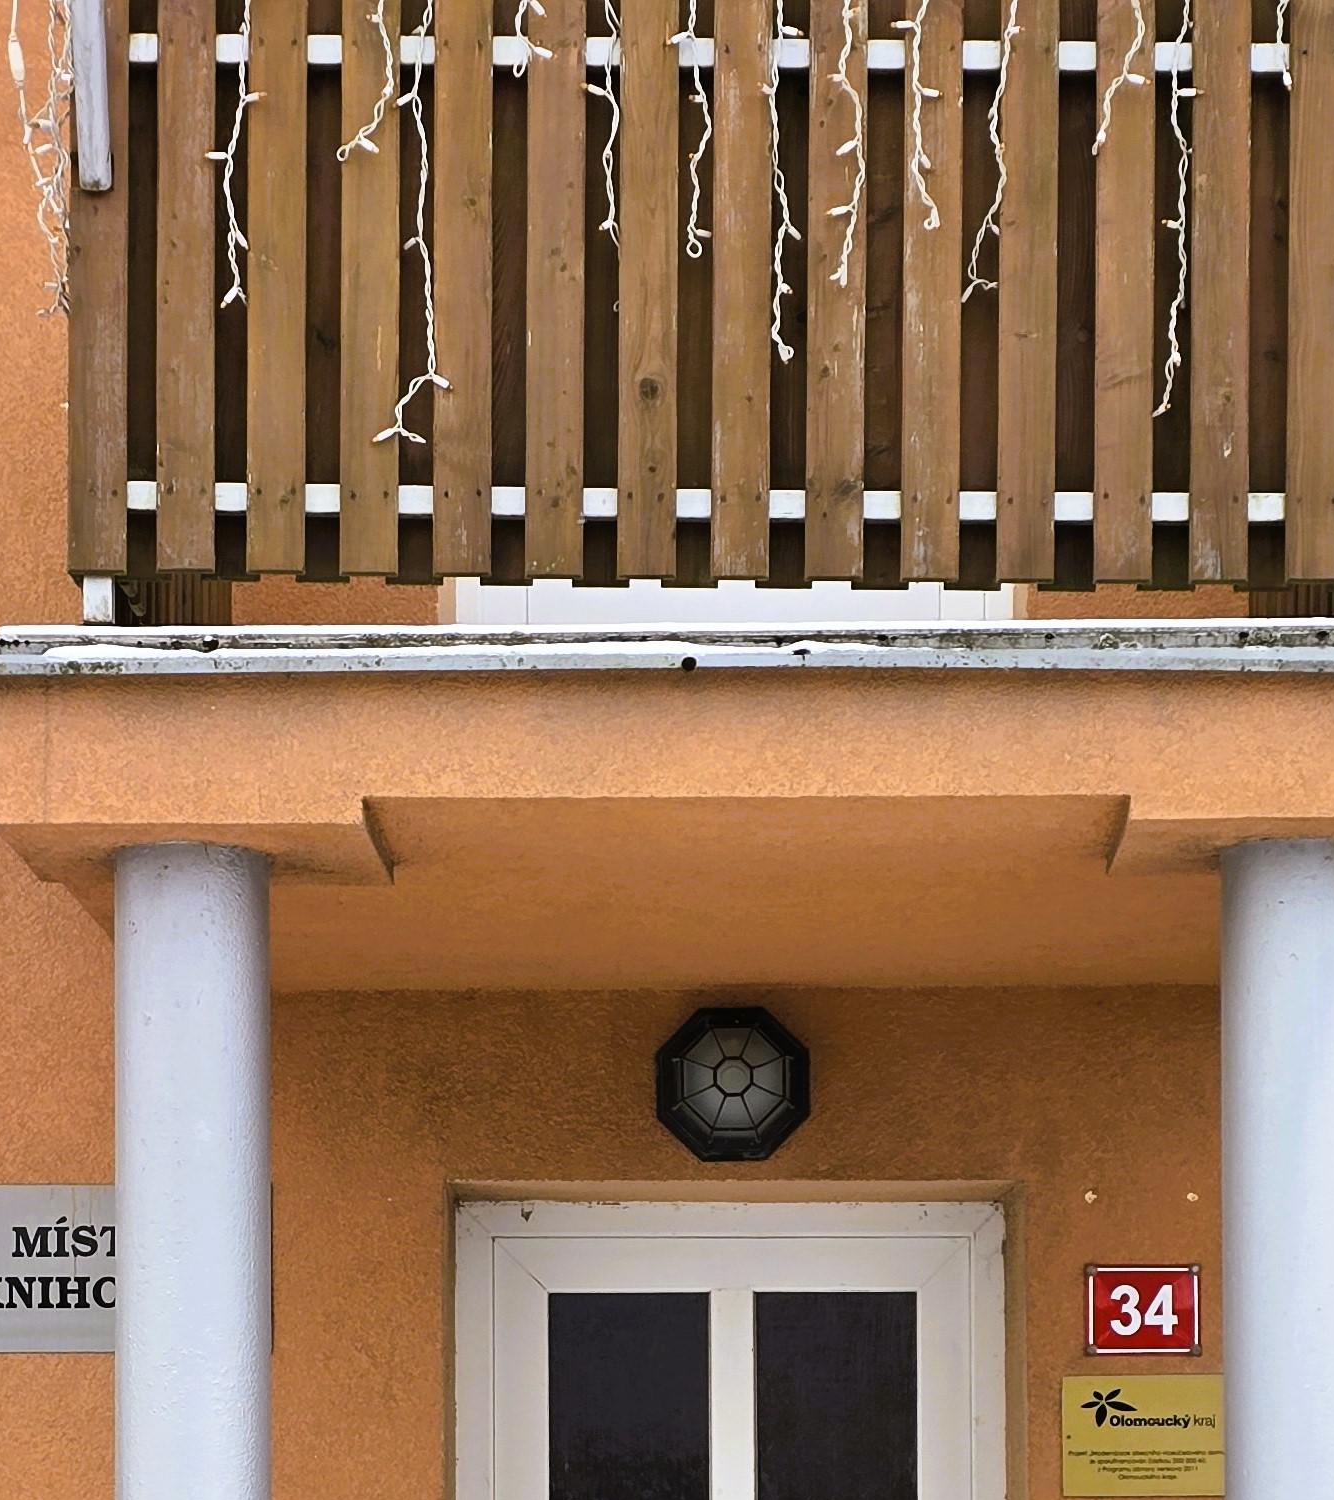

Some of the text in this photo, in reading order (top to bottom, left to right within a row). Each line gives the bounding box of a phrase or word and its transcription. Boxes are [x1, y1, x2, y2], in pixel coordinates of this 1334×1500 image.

[1110, 1284, 1178, 1336] 34
[1109, 1414, 1216, 1429] Olomoucký kraj
